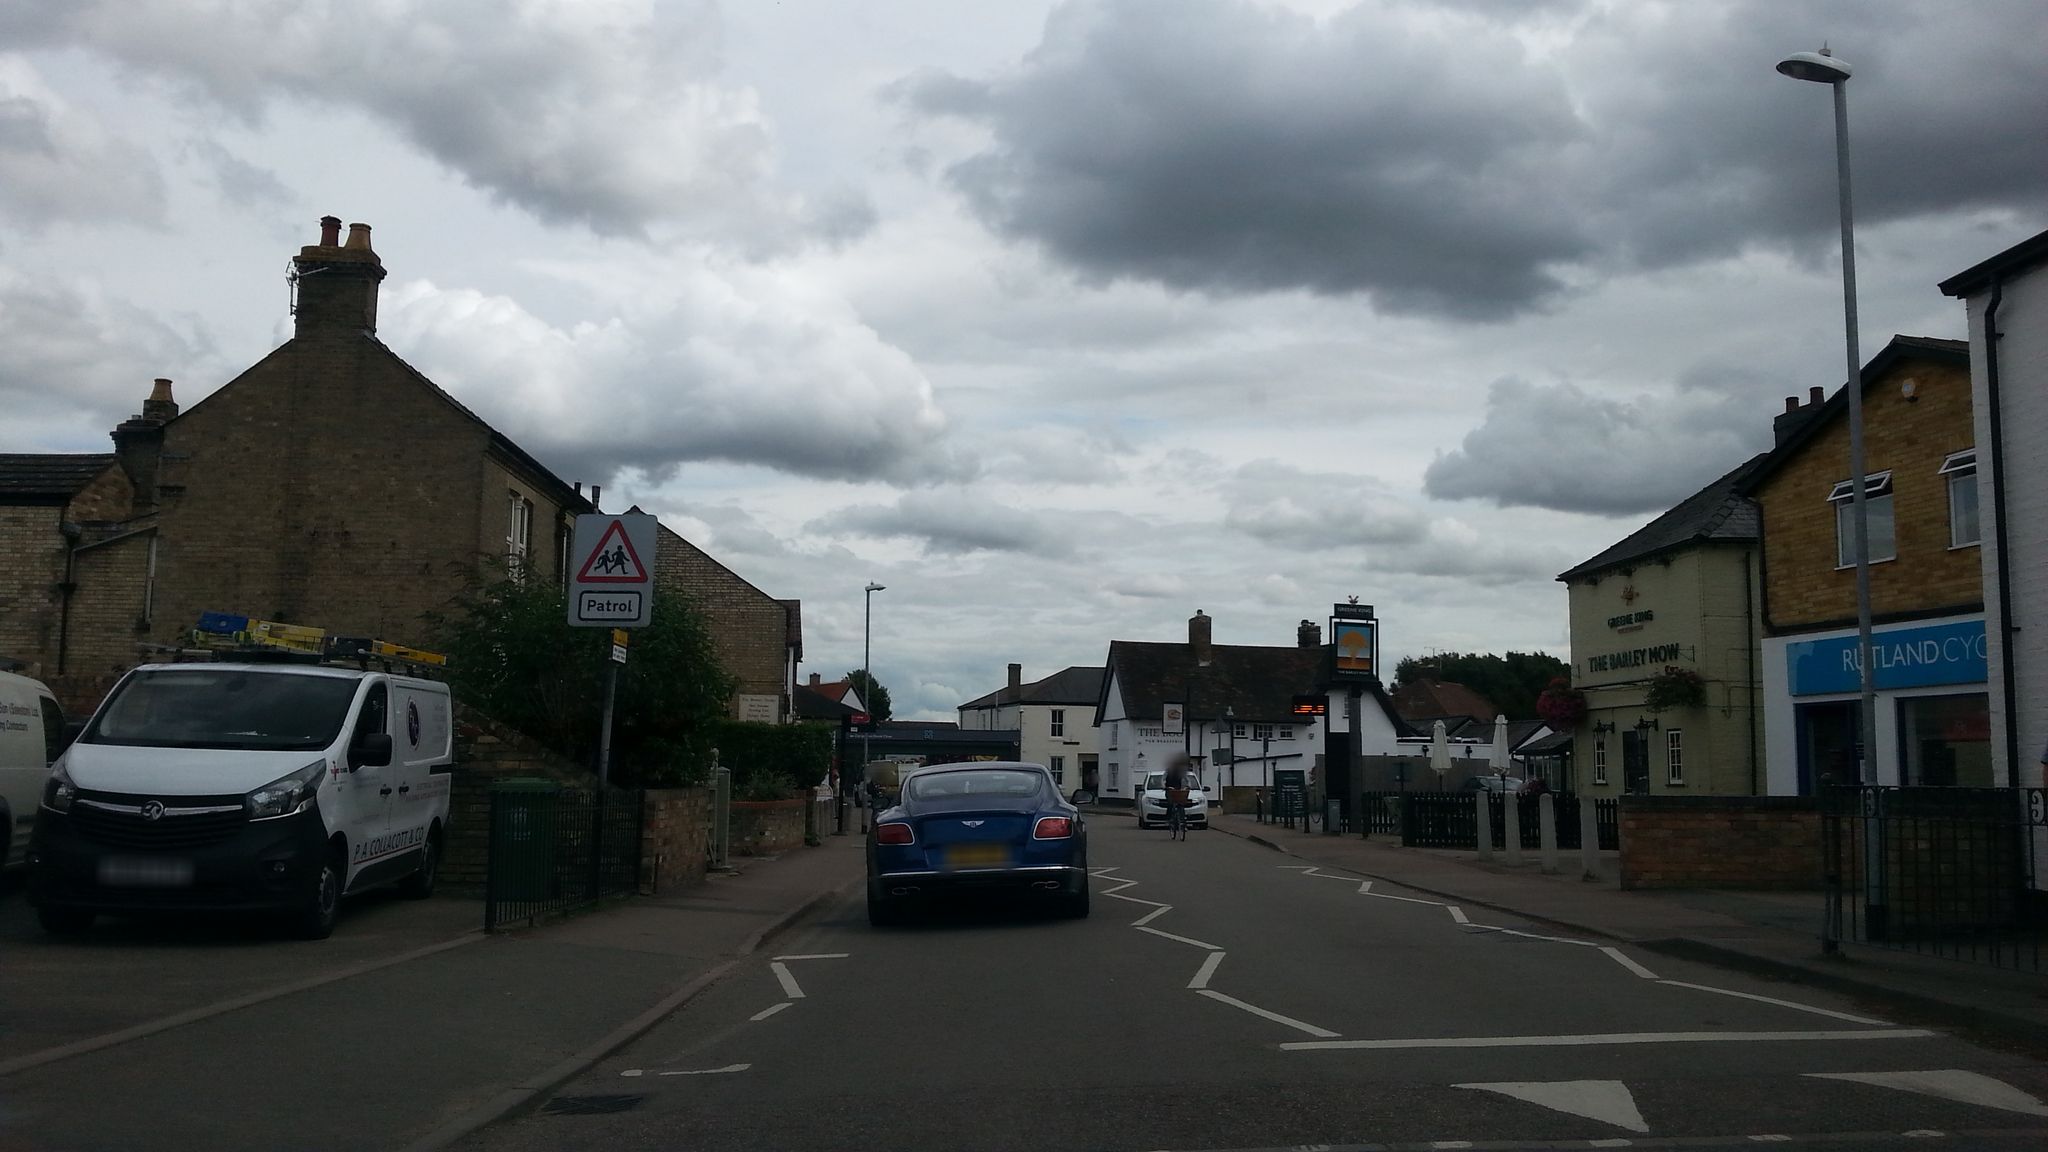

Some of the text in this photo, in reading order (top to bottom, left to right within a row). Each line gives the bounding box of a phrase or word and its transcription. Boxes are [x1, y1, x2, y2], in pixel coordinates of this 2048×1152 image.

[587, 599, 633, 612] Patrol
[1607, 610, 1654, 628] GREENE KING
[1588, 642, 1680, 673] THE BARLEY MOW
[1138, 727, 1161, 737] THE
[354, 844, 360, 860] P
[361, 842, 368, 859] A
[370, 831, 408, 856] COLLACOTT
[415, 826, 424, 842] CO
